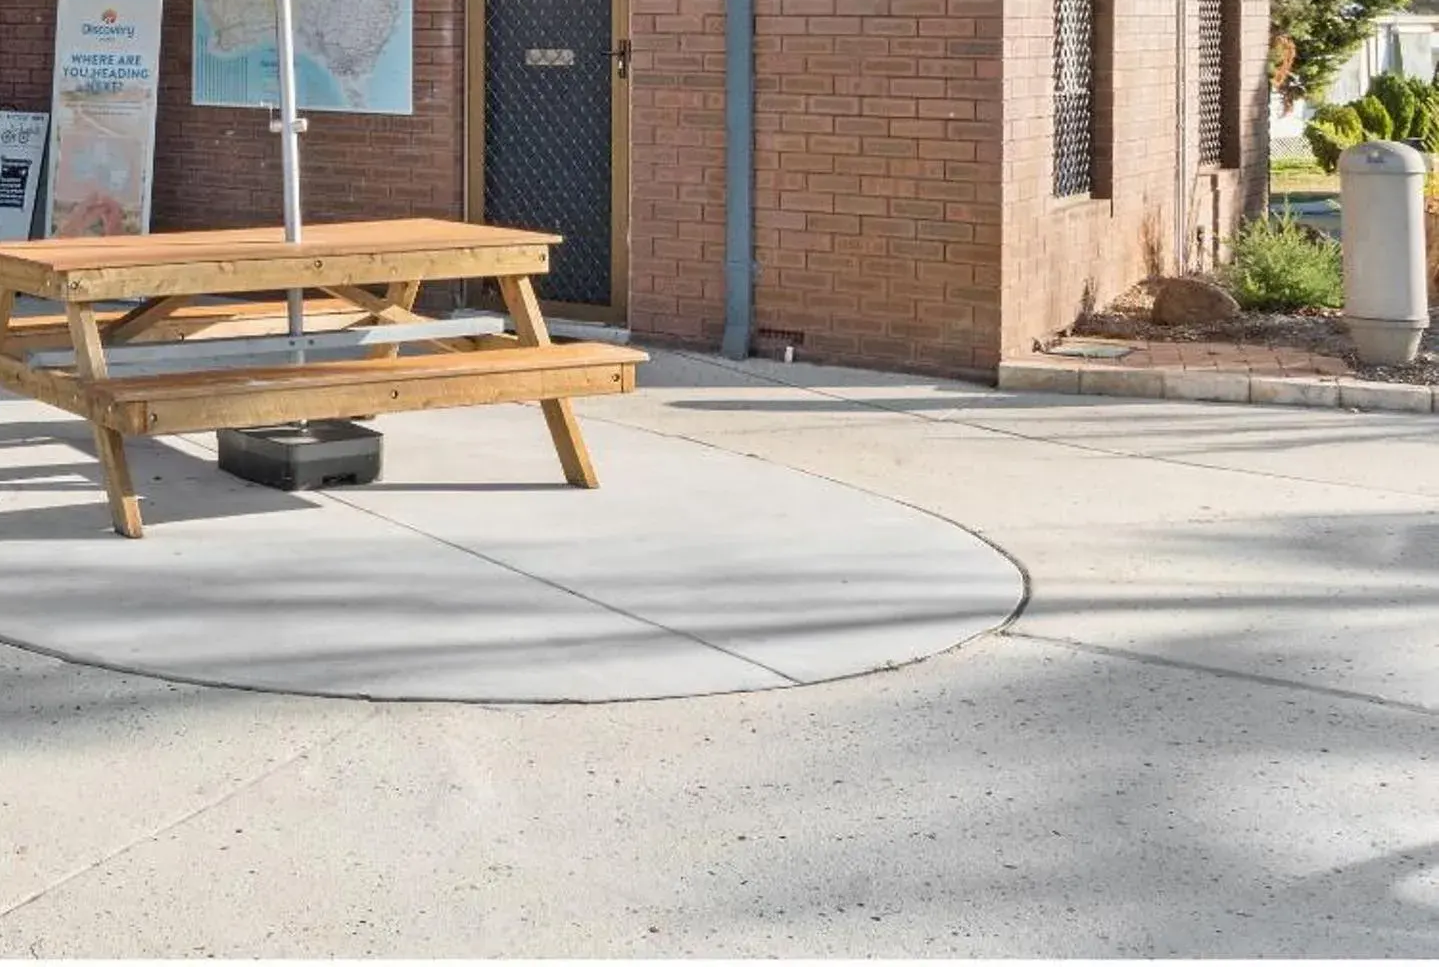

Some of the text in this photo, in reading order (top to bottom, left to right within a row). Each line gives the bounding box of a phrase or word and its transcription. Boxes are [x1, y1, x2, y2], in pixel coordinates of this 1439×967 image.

[71, 54, 142, 67] WHERE ARE
[62, 66, 150, 80] YOU HEADING
